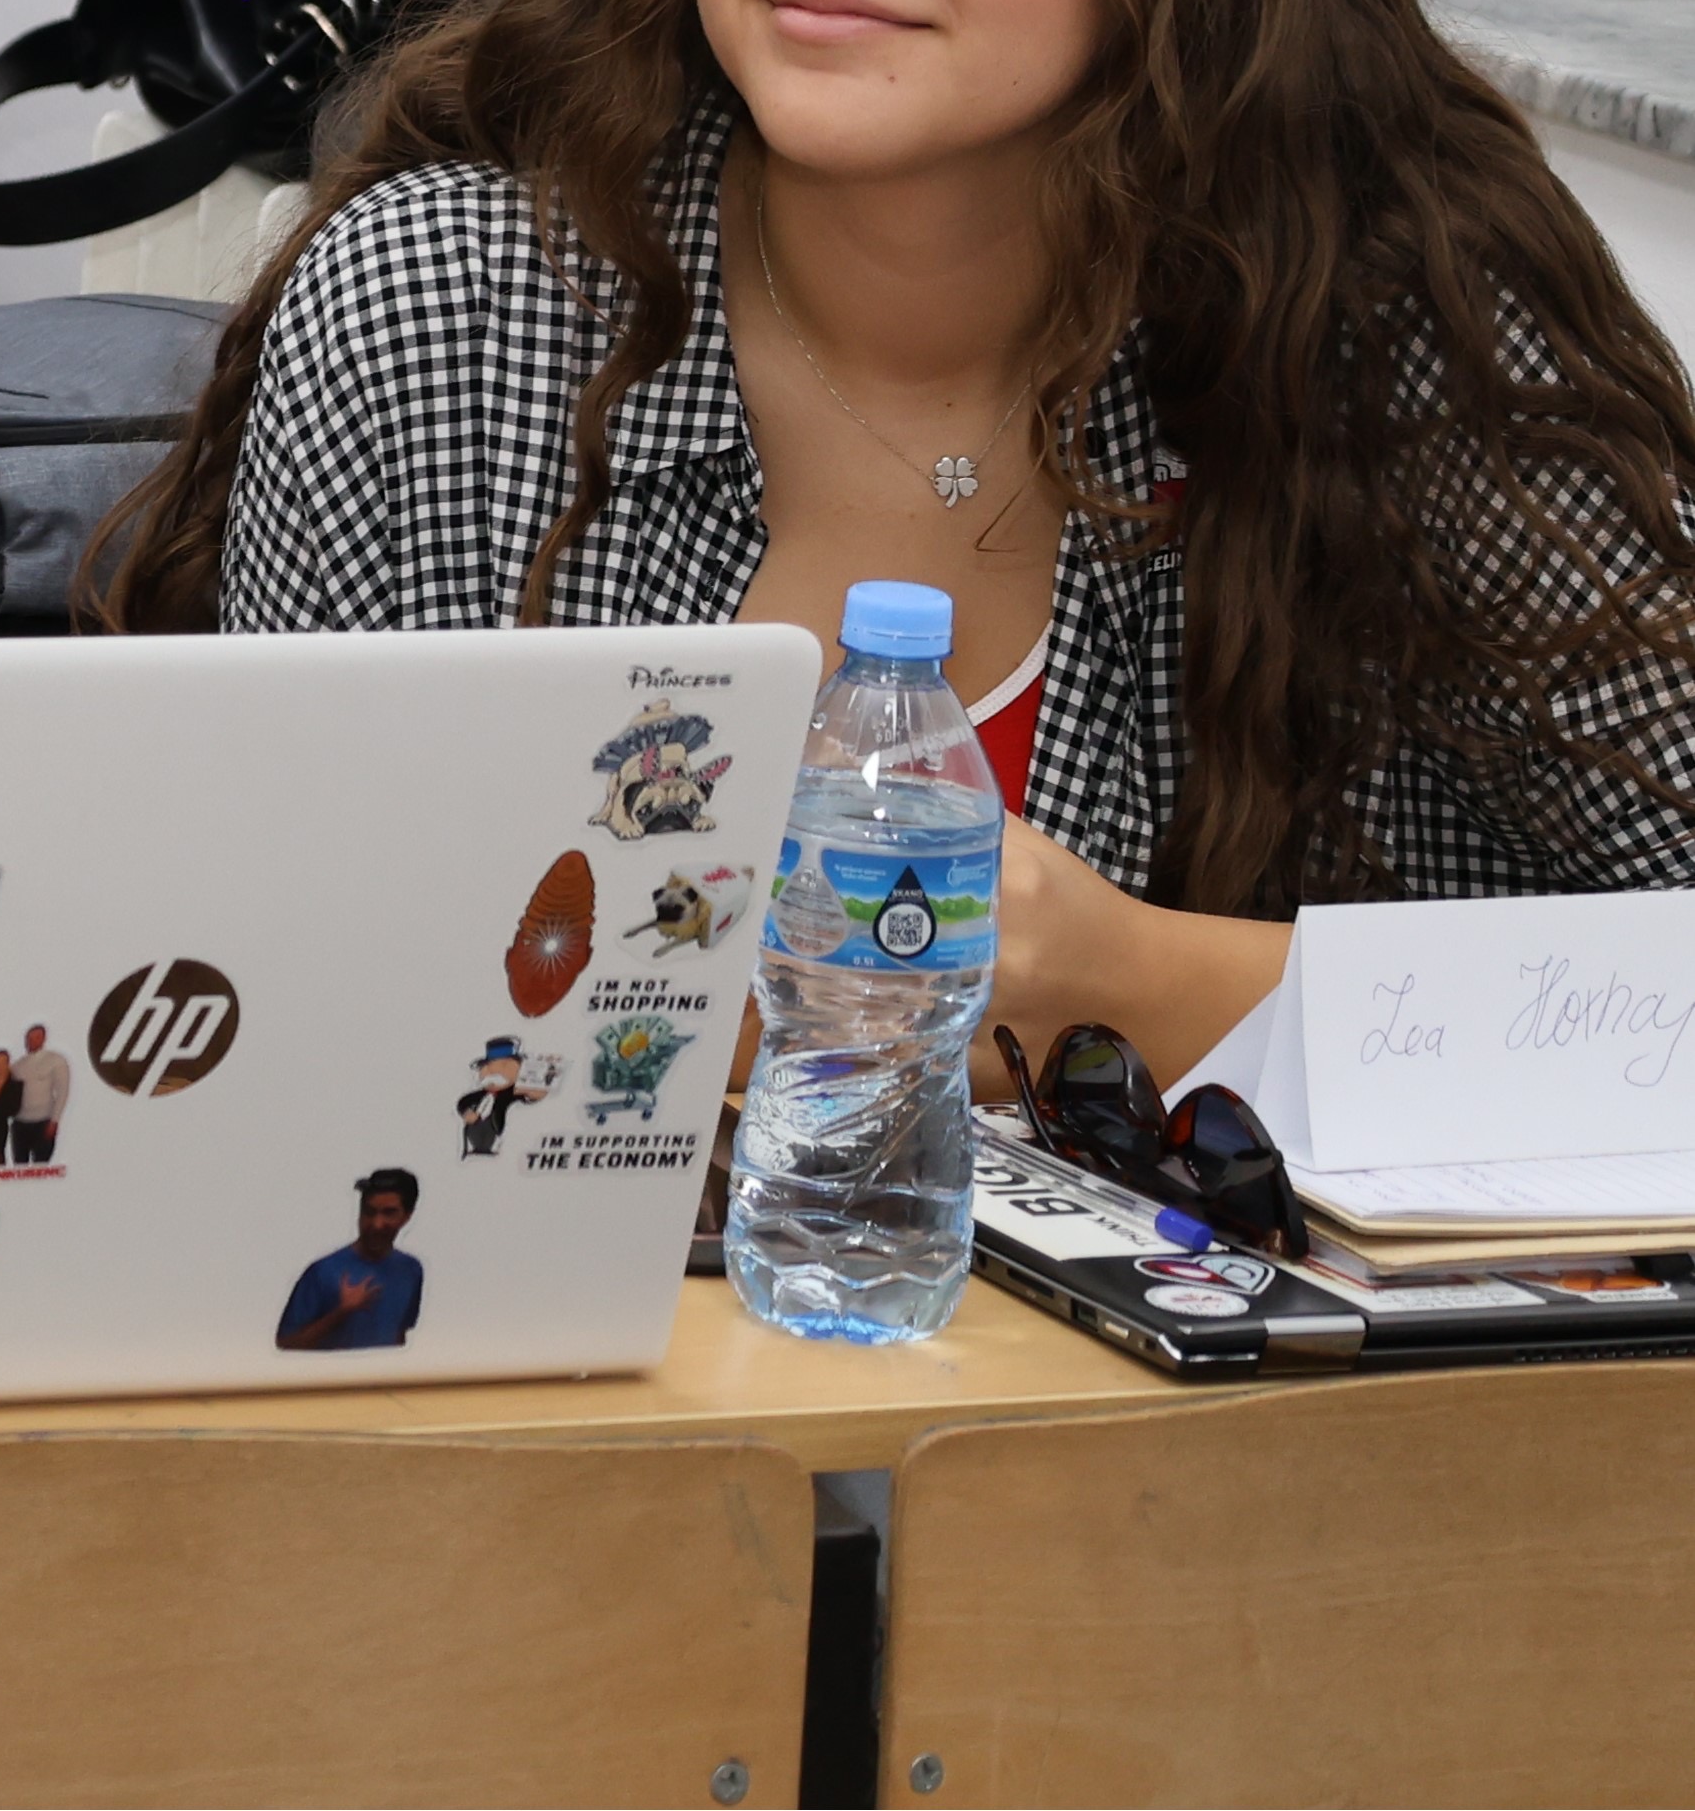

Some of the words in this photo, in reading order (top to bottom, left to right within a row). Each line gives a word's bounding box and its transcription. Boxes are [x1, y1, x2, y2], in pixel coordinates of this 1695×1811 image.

[595, 979, 620, 993] IM
[630, 979, 670, 992] NOT
[587, 995, 709, 1012] SHOPPING
[96, 958, 234, 1098] hp
[541, 1136, 569, 1149] IM
[573, 1134, 697, 1149] SUPPORTING
[526, 1152, 571, 1170] THE
[578, 1150, 695, 1169] ECONOMY
